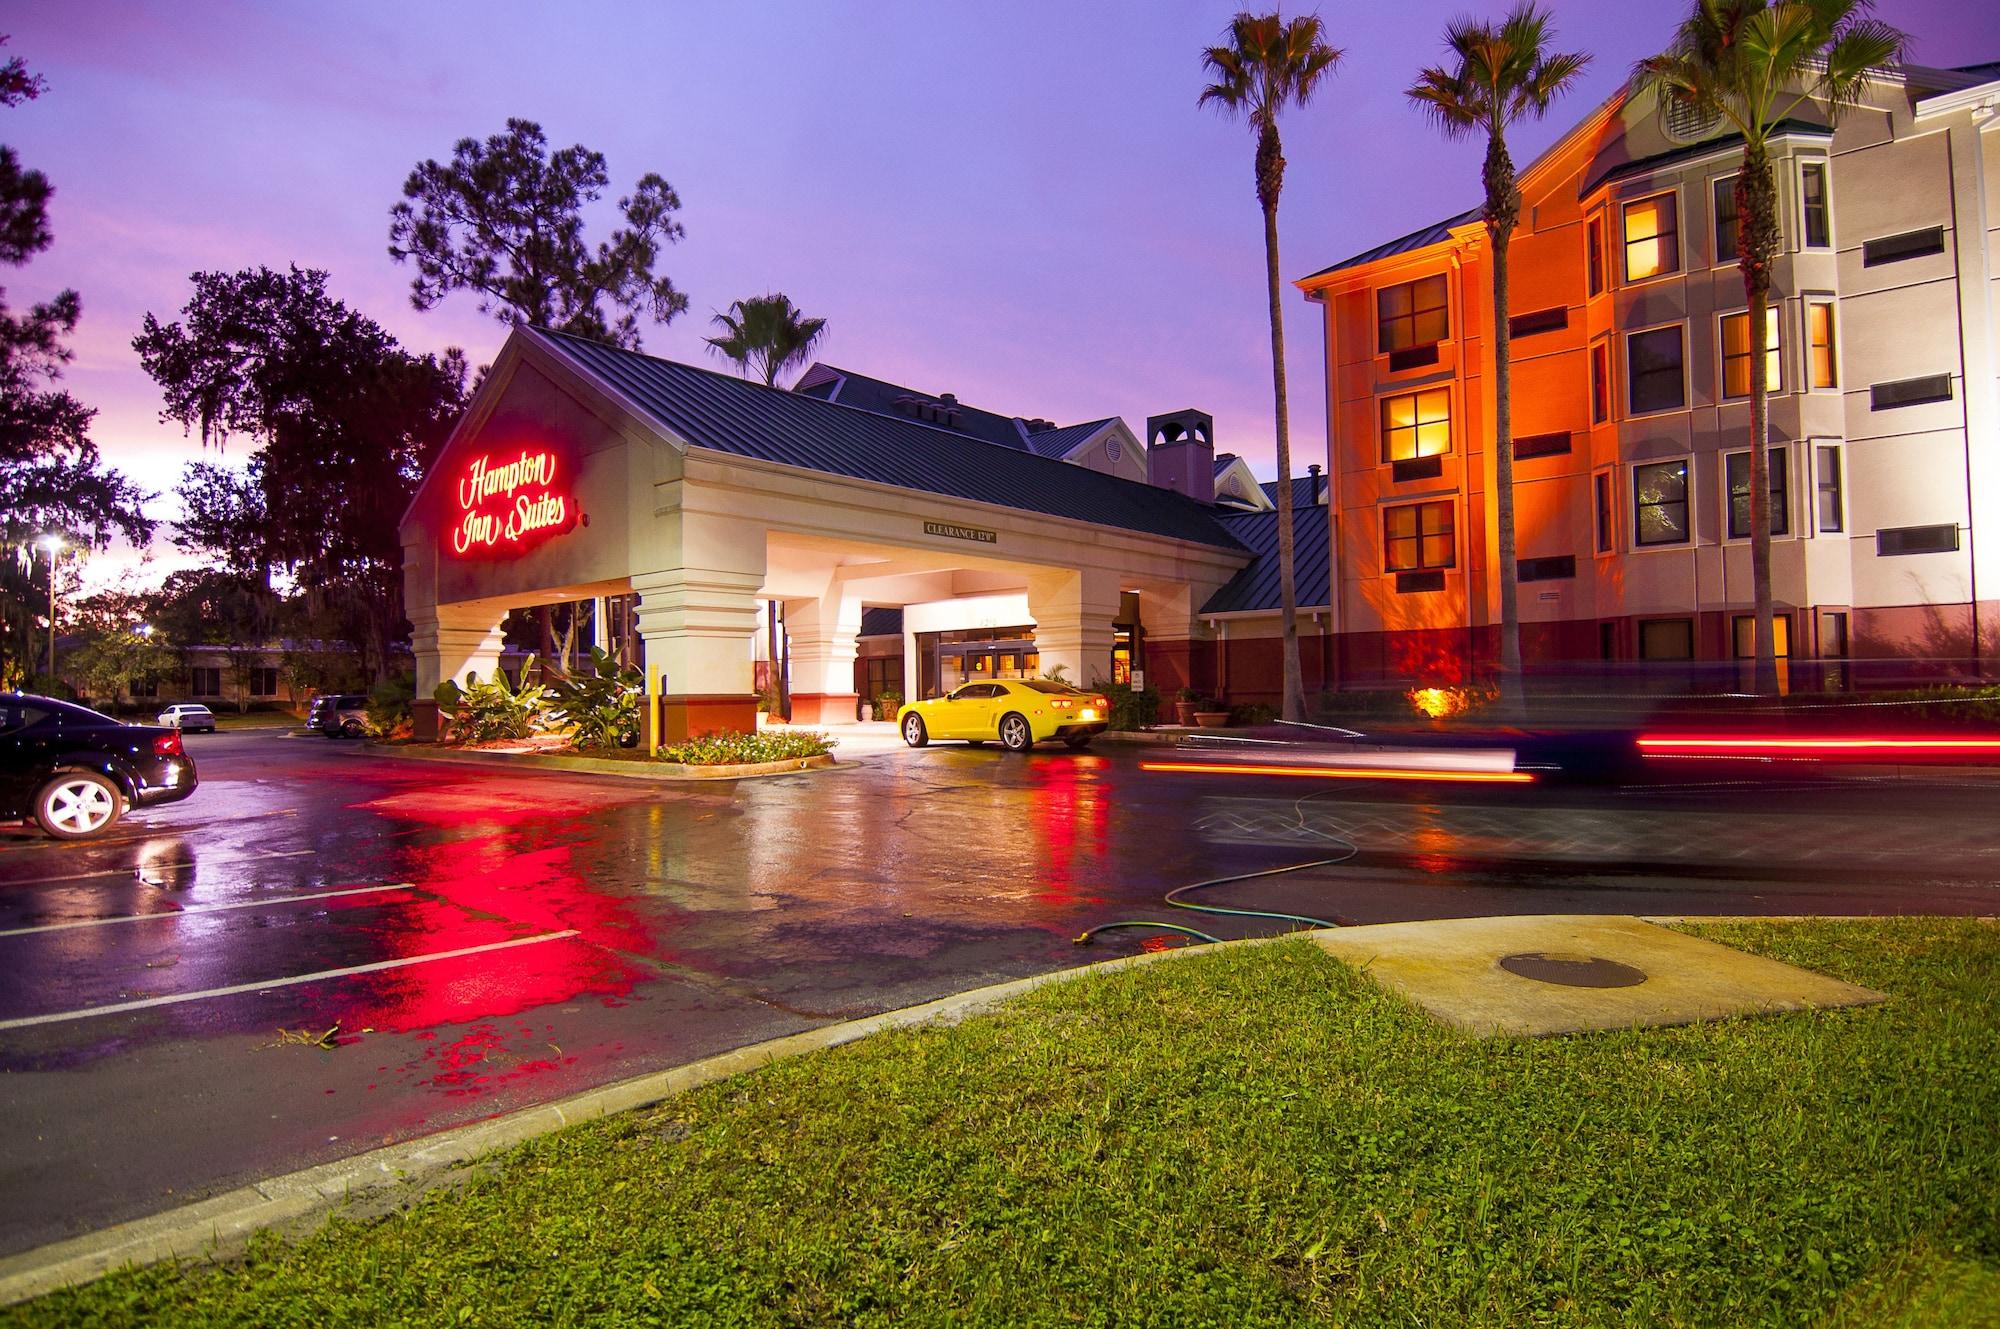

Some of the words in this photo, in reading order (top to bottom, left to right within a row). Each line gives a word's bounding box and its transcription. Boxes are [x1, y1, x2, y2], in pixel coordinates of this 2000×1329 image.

[460, 451, 556, 509] Hampton
[454, 510, 500, 553] Inn
[511, 491, 565, 536] Suites
[927, 524, 976, 539] CLEARANCE
